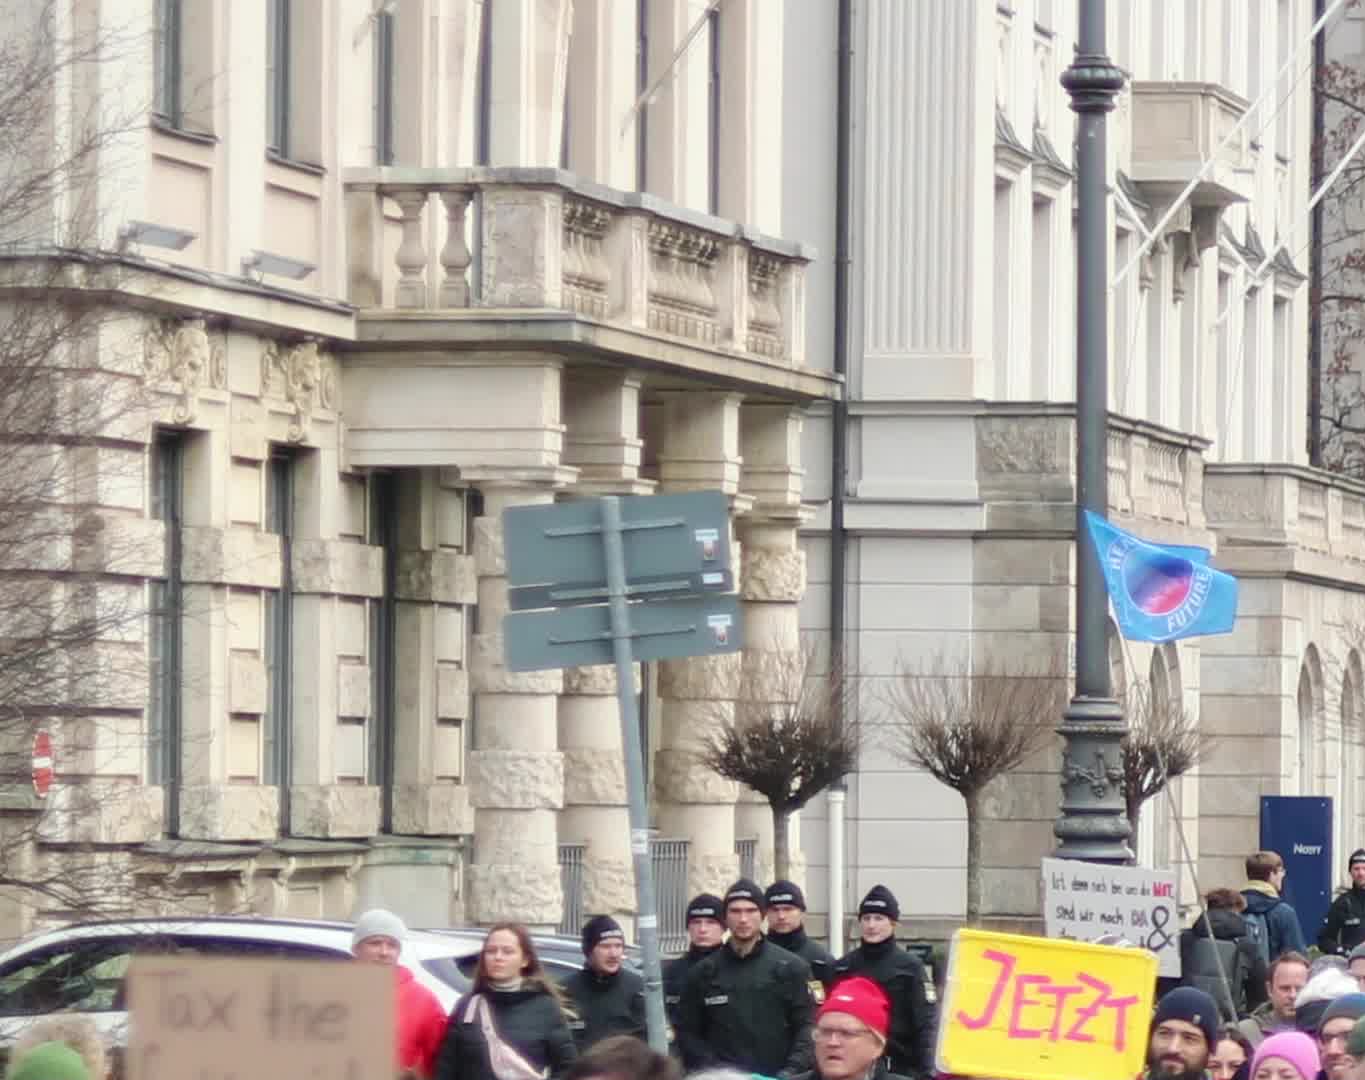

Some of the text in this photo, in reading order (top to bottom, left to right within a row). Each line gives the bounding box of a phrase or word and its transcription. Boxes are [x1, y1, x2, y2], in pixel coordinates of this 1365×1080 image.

[1167, 568, 1210, 633] FUTURE
[131, 969, 350, 1042] Tax the
[956, 948, 1139, 1053] JETZT
